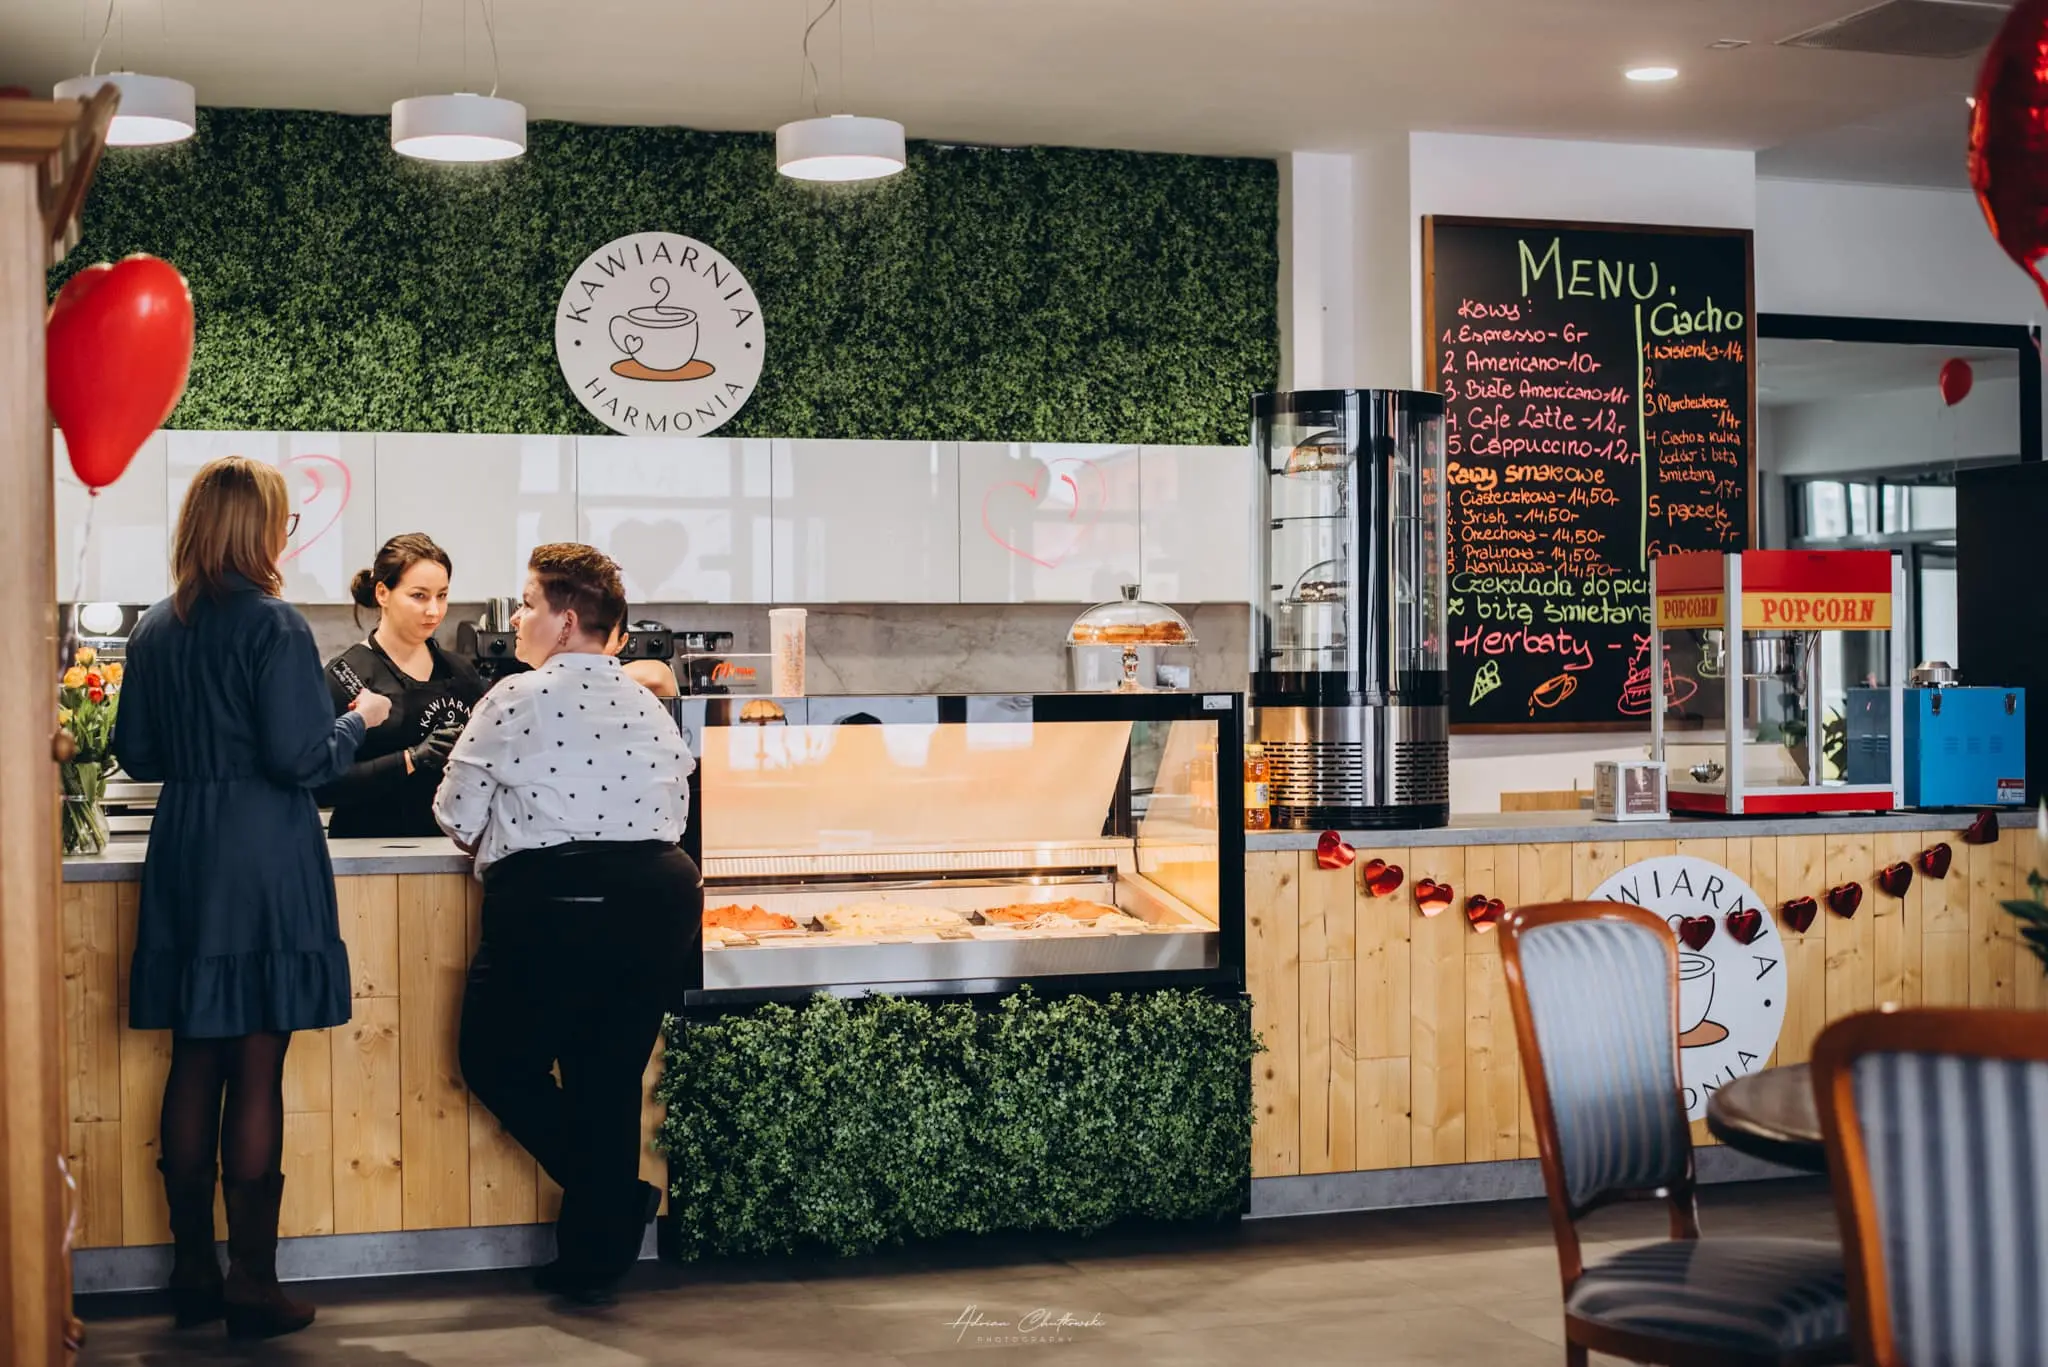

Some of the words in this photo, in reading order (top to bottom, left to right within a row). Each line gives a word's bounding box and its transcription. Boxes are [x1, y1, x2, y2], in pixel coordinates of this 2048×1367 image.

[566, 241, 753, 328] KAWIARNIA
[585, 377, 743, 433] HARMONIA
[1518, 403, 1577, 431] Latte
[1504, 464, 1606, 484] smakowe
[1663, 596, 1719, 620] POPCORN
[1760, 597, 1876, 624] POPCORN
[1455, 624, 1594, 671] Herbaty
